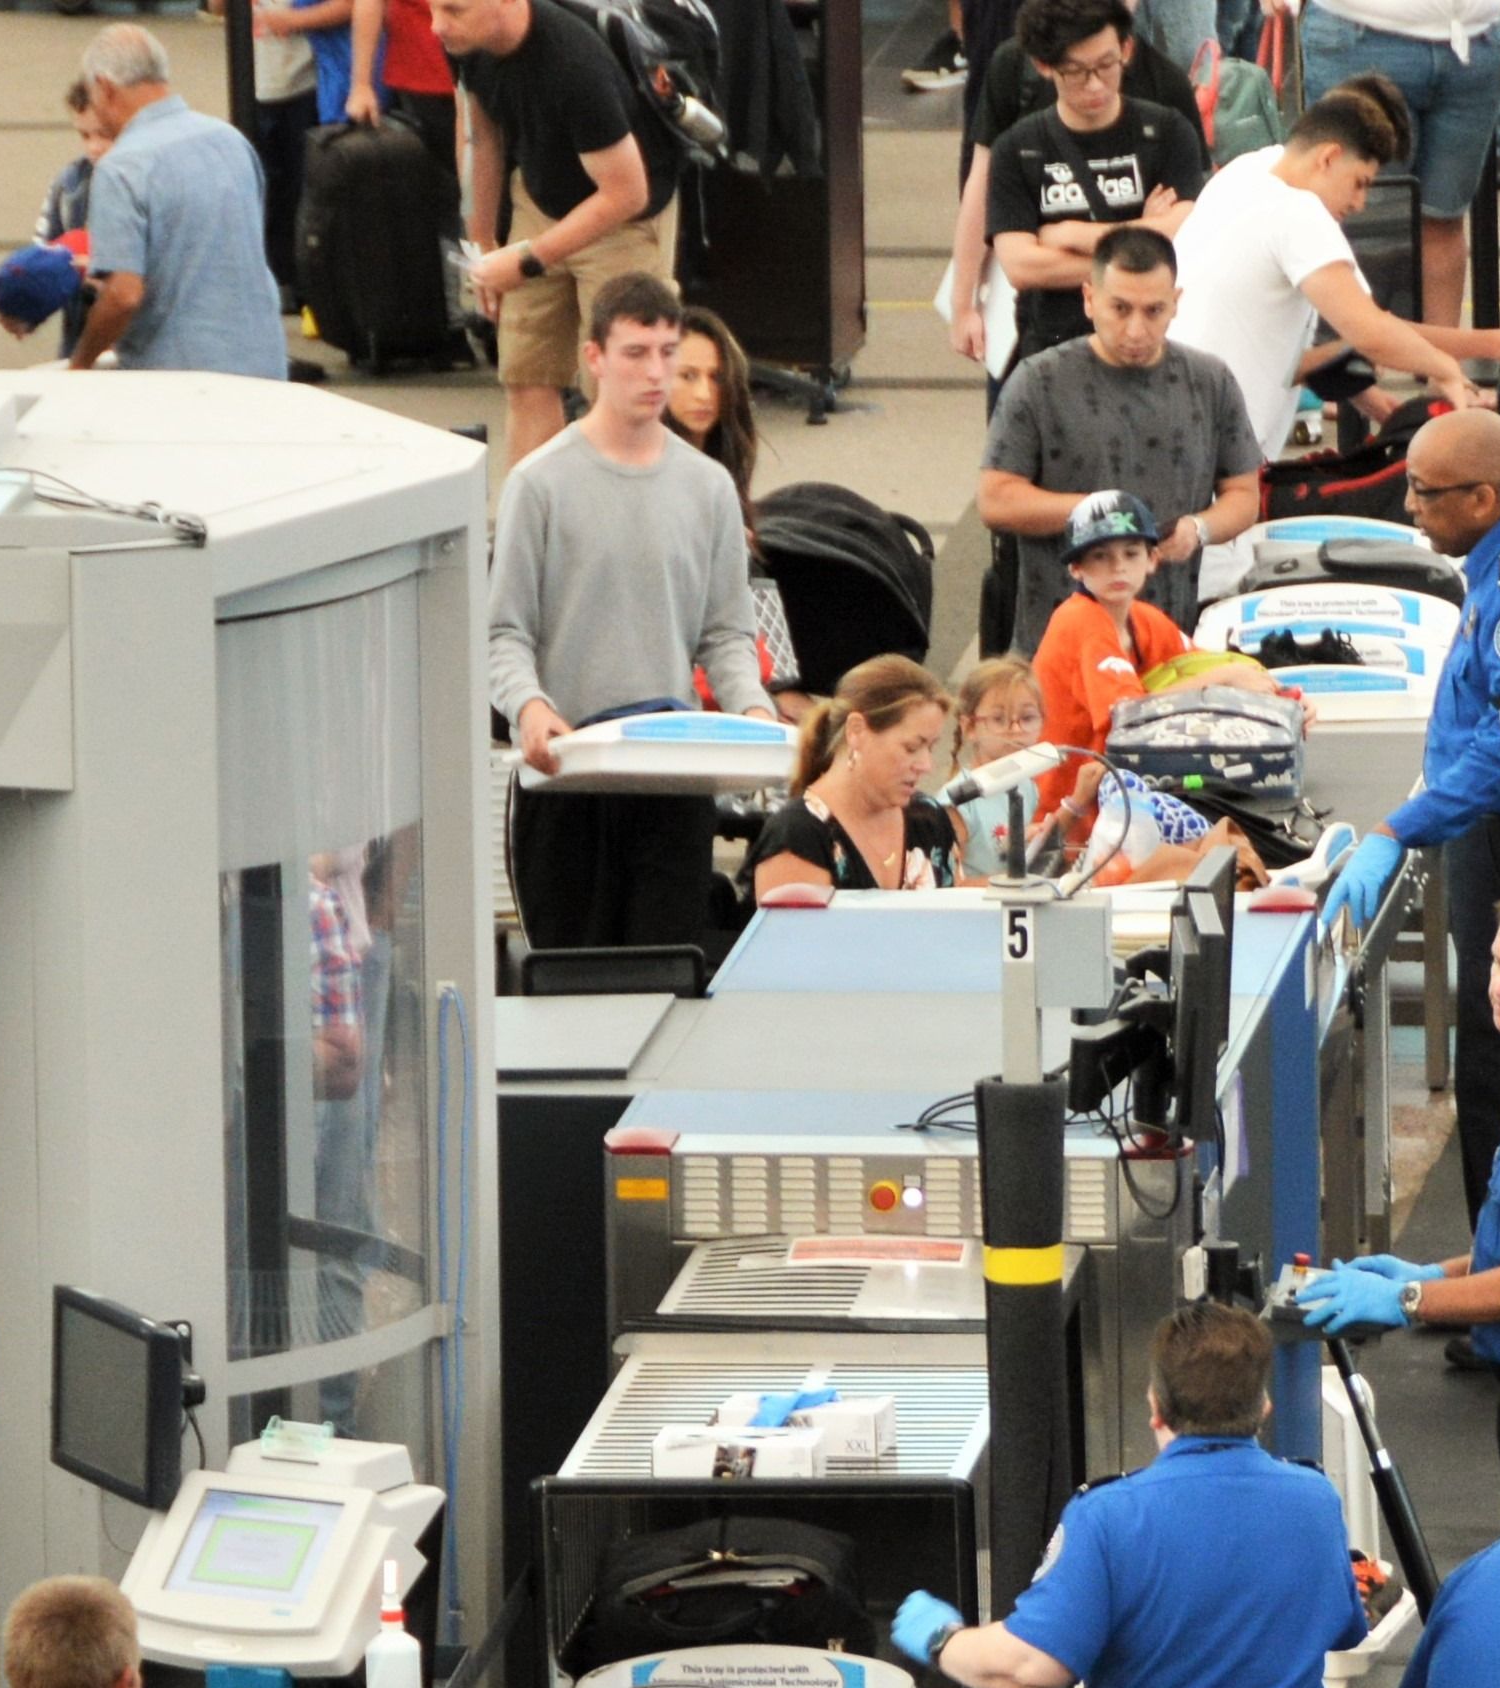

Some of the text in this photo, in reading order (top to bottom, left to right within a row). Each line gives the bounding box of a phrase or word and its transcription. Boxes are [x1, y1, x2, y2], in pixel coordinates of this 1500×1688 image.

[1008, 910, 1030, 958] 5
[844, 1439, 871, 1453] XXL
[682, 1663, 809, 1676] This tray is protected with
